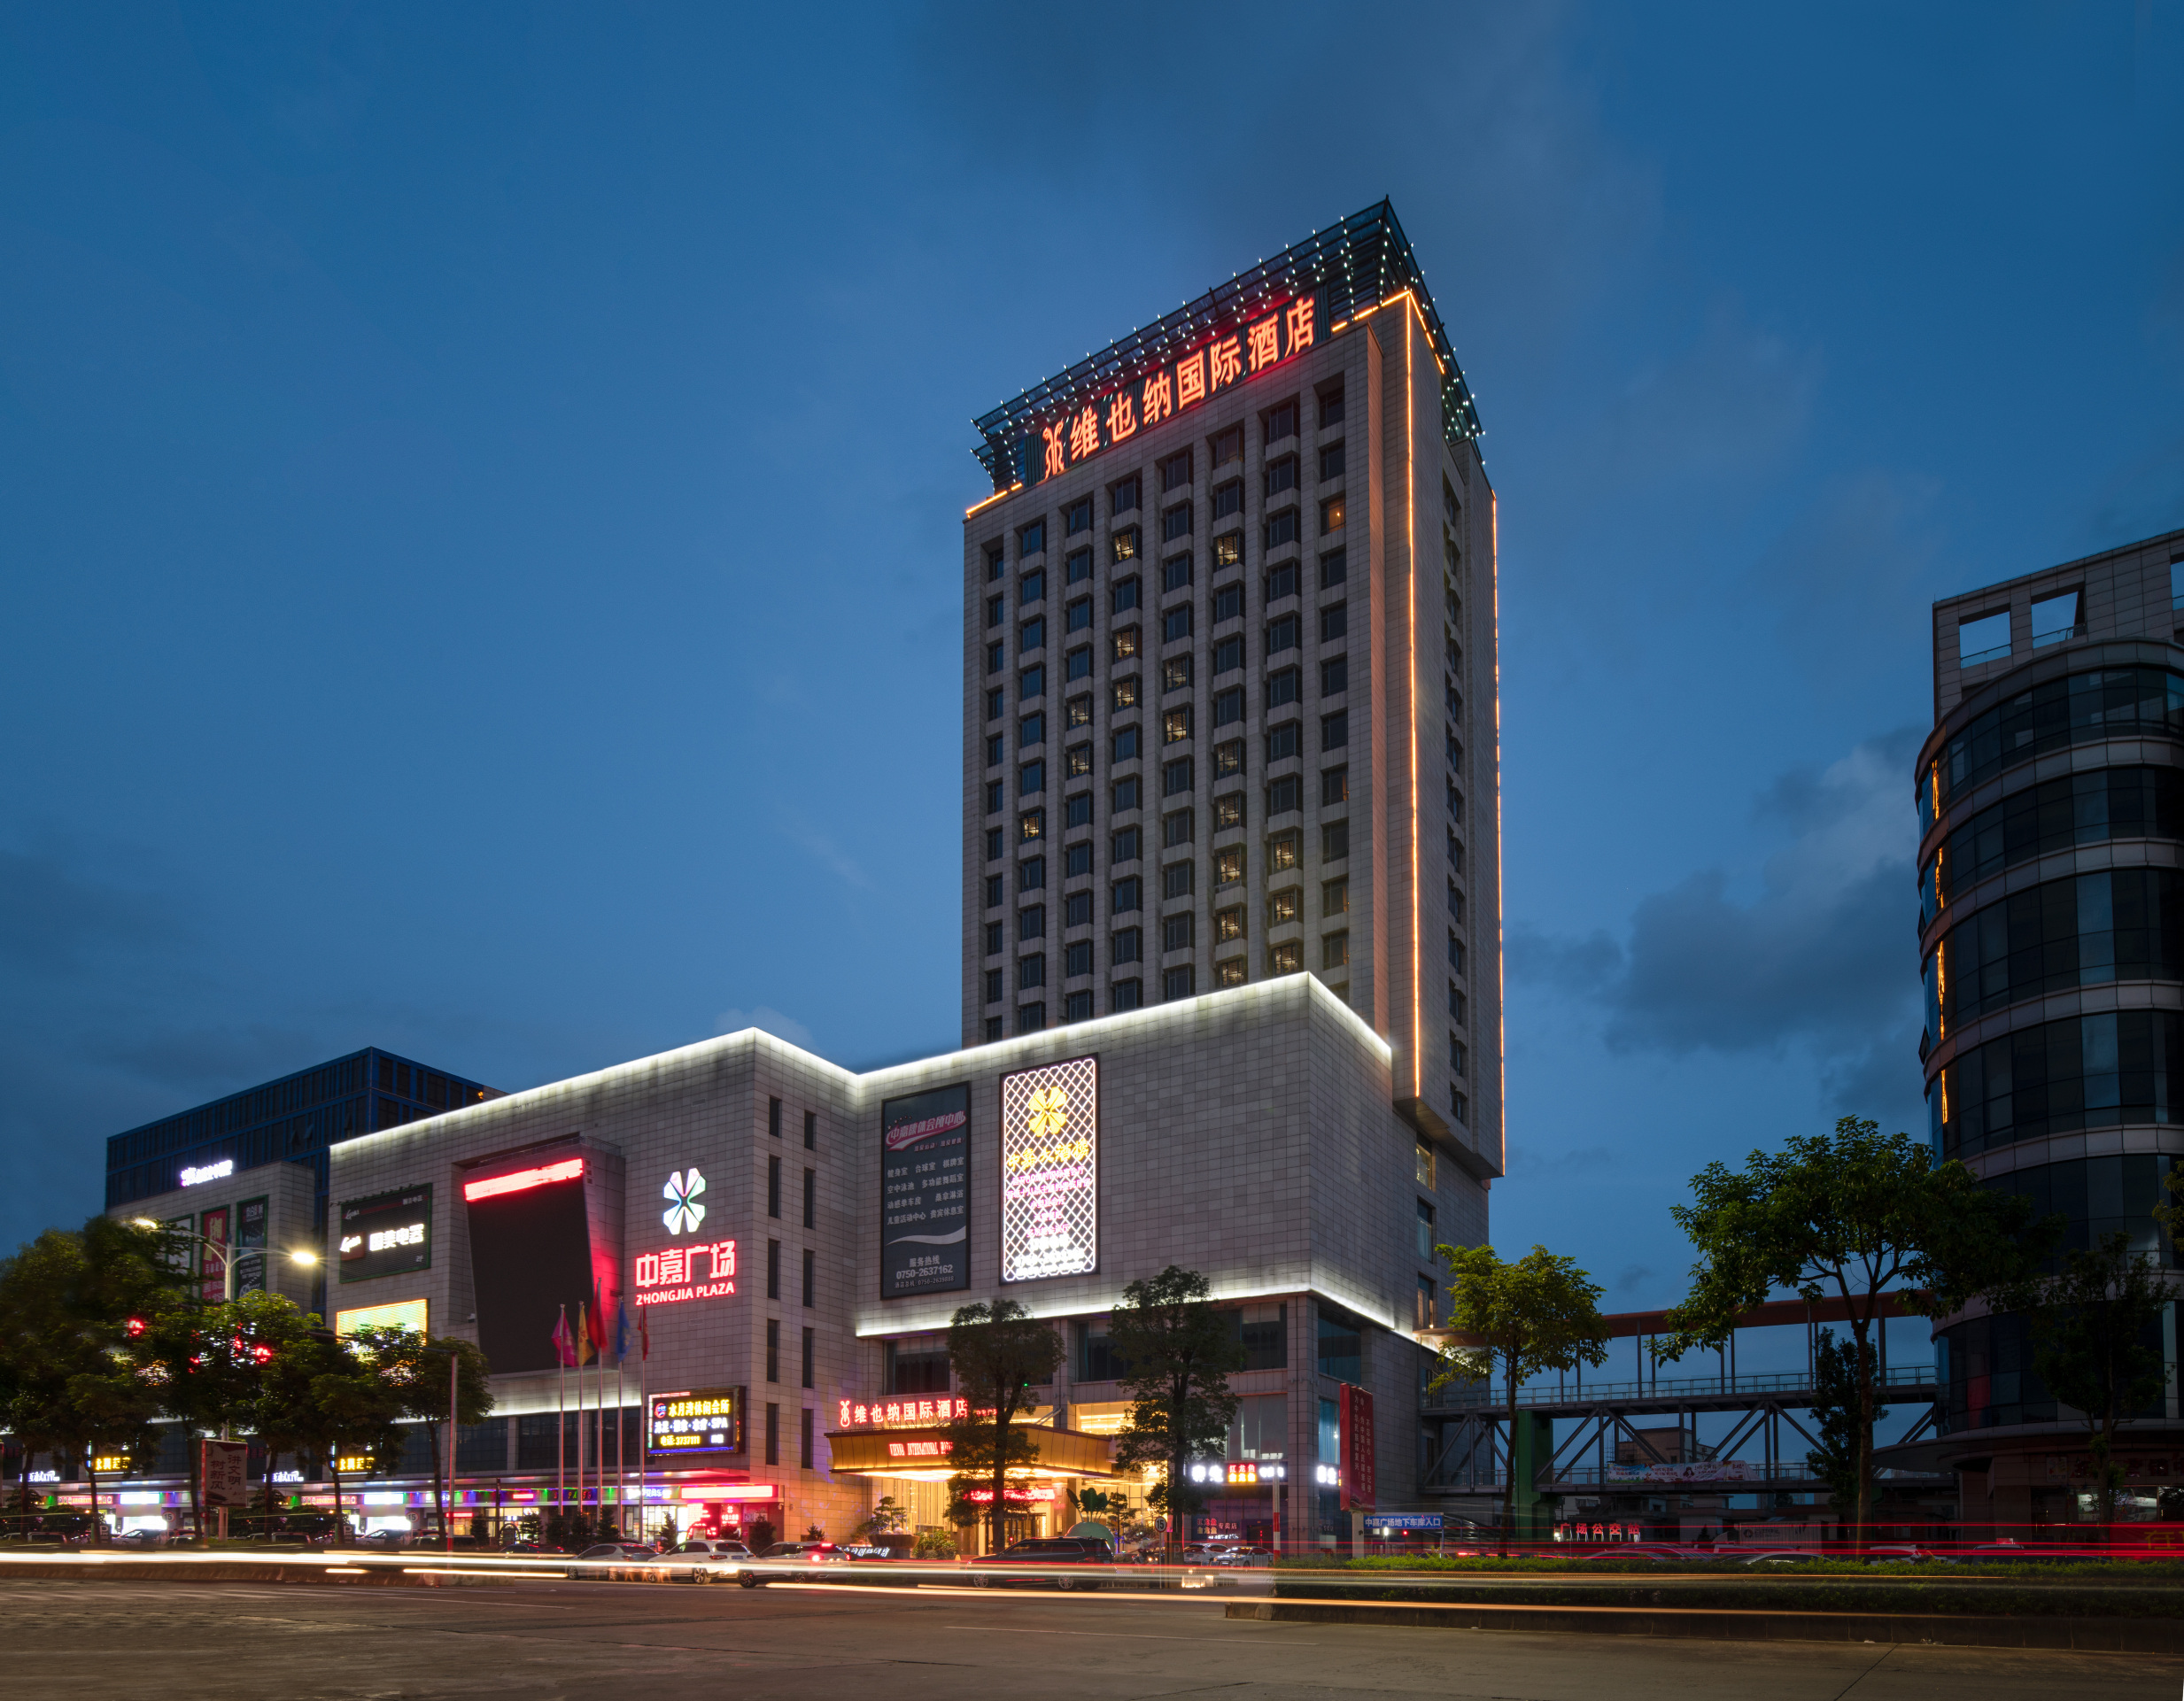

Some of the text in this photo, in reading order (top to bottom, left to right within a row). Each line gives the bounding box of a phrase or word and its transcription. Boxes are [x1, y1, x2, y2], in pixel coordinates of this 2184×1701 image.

[1069, 296, 1315, 460] 维也纳国际酒店
[915, 1162, 936, 1173] 台球室
[942, 1156, 964, 1169] 棋牌室
[887, 1211, 926, 1225] 儿童活动中心
[369, 1223, 424, 1252] 国美电器
[635, 1240, 736, 1288] 中嘉广场
[909, 1255, 941, 1268] 服务热线
[895, 1264, 954, 1280] 0750-2637162
[635, 1281, 735, 1306] ZHONGJIA PLAZA
[854, 1398, 968, 1424] 维也纳国际酒店
[210, 1459, 227, 1490] 树新风
[228, 1454, 242, 1487] 讲文明
[1228, 1464, 1256, 1473] 红龙鱼
[1156, 1519, 1165, 1529] 15
[1365, 1518, 1441, 1527] 中嘉广场地下车库入口
[1553, 1522, 1640, 1535] 广场公交站
